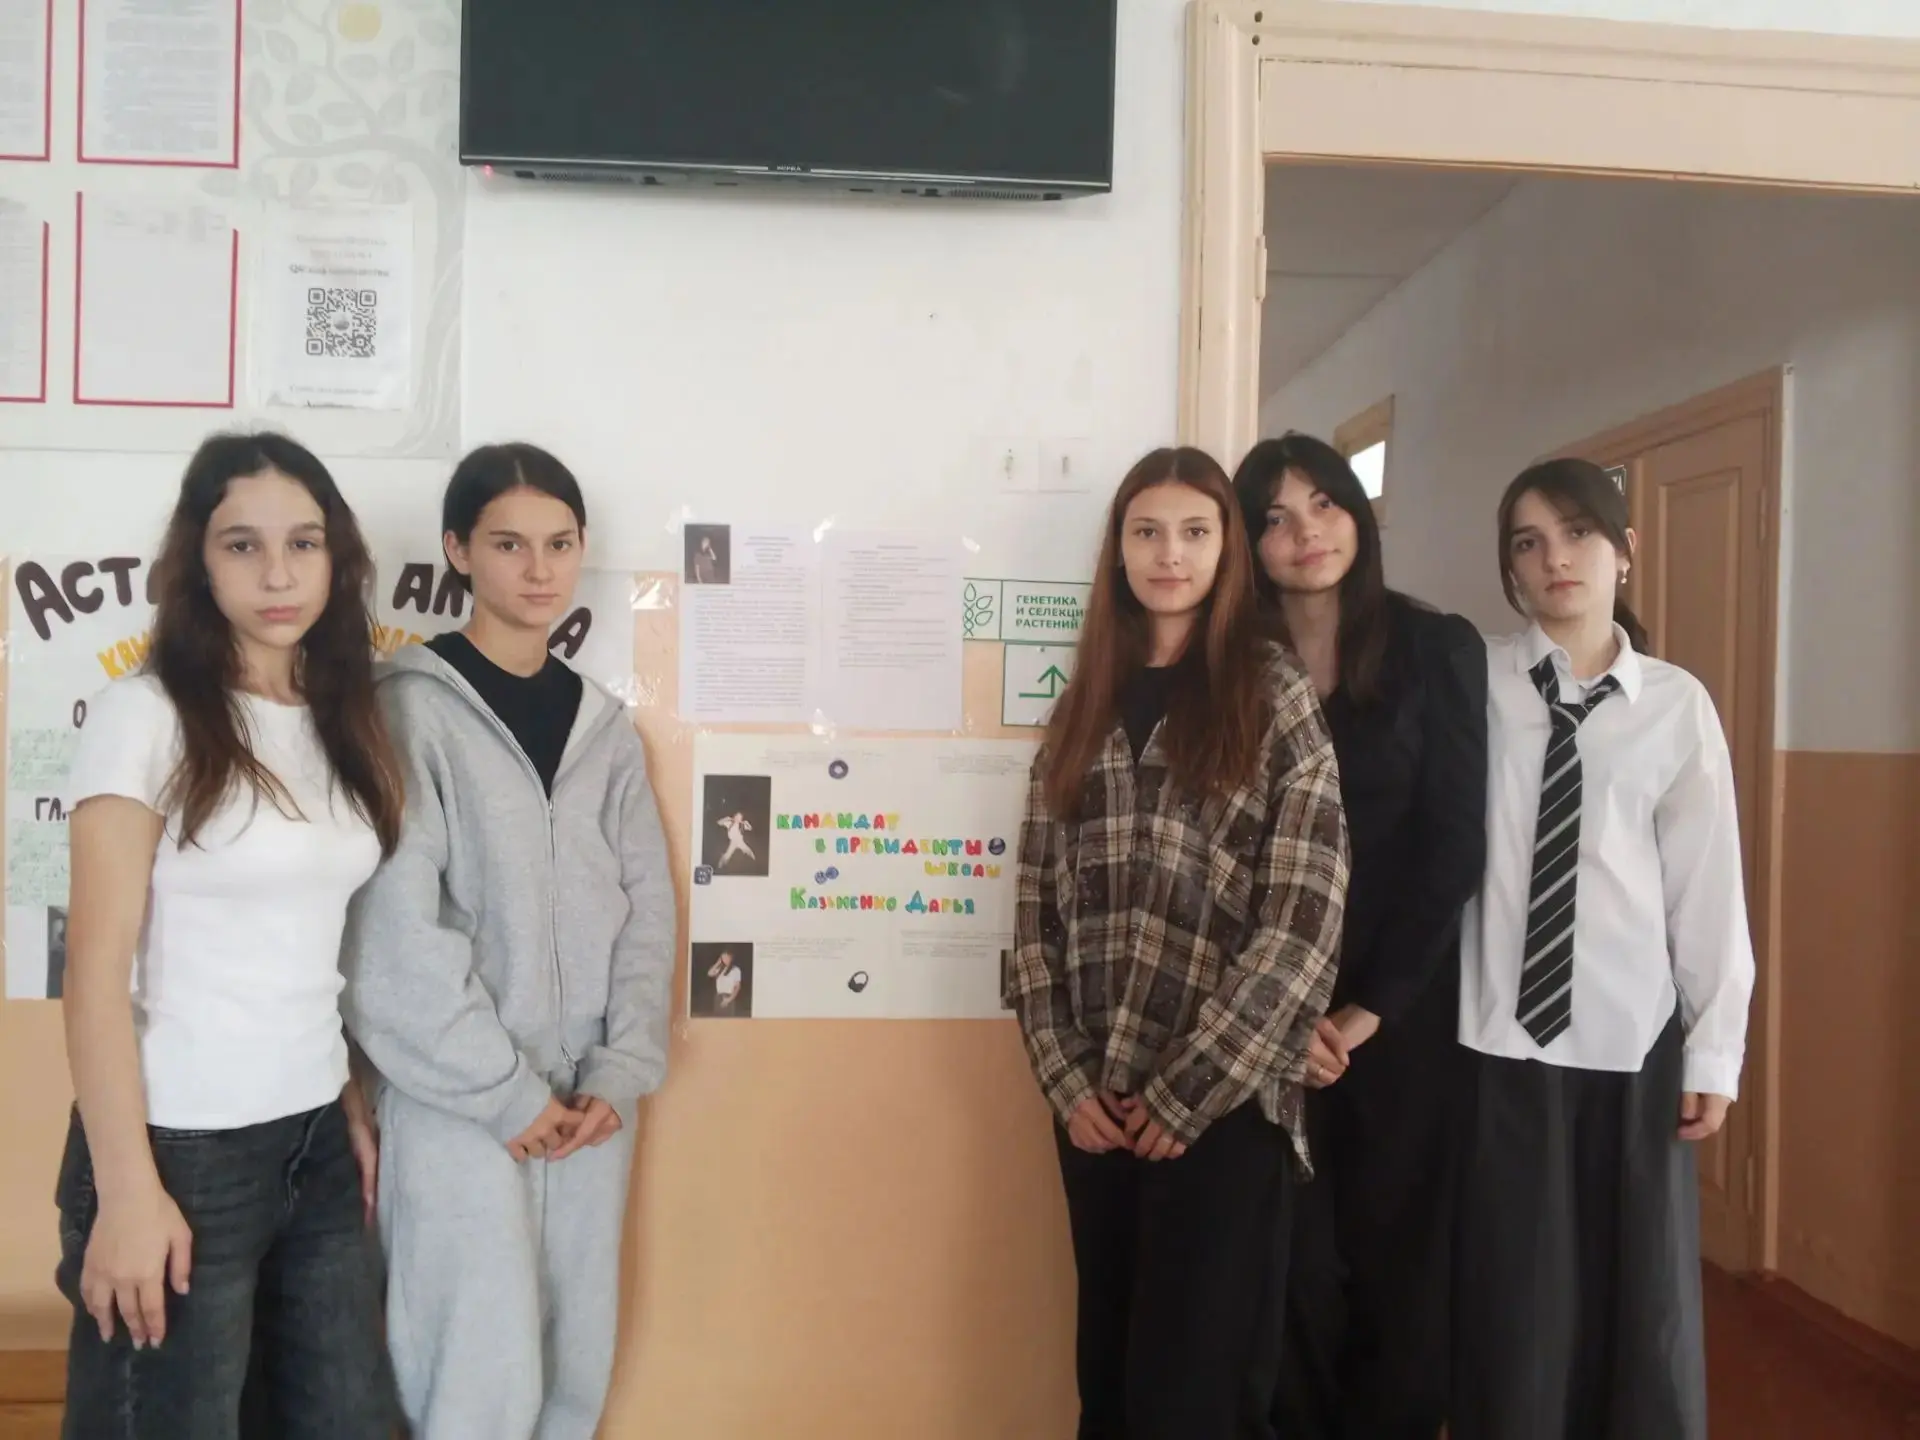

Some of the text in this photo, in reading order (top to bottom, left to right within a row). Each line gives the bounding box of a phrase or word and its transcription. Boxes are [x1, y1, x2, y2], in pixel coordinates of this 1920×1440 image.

[1016, 594, 1078, 606] ГЕНЕТИКА
[1016, 606, 1084, 620] И СЕЛЕКЦИ
[1015, 618, 1079, 630] РАСТЕНИЙ
[776, 812, 900, 831] КАНДИДАТ
[835, 837, 983, 856] ПРЕЗИДЕНТЫ
